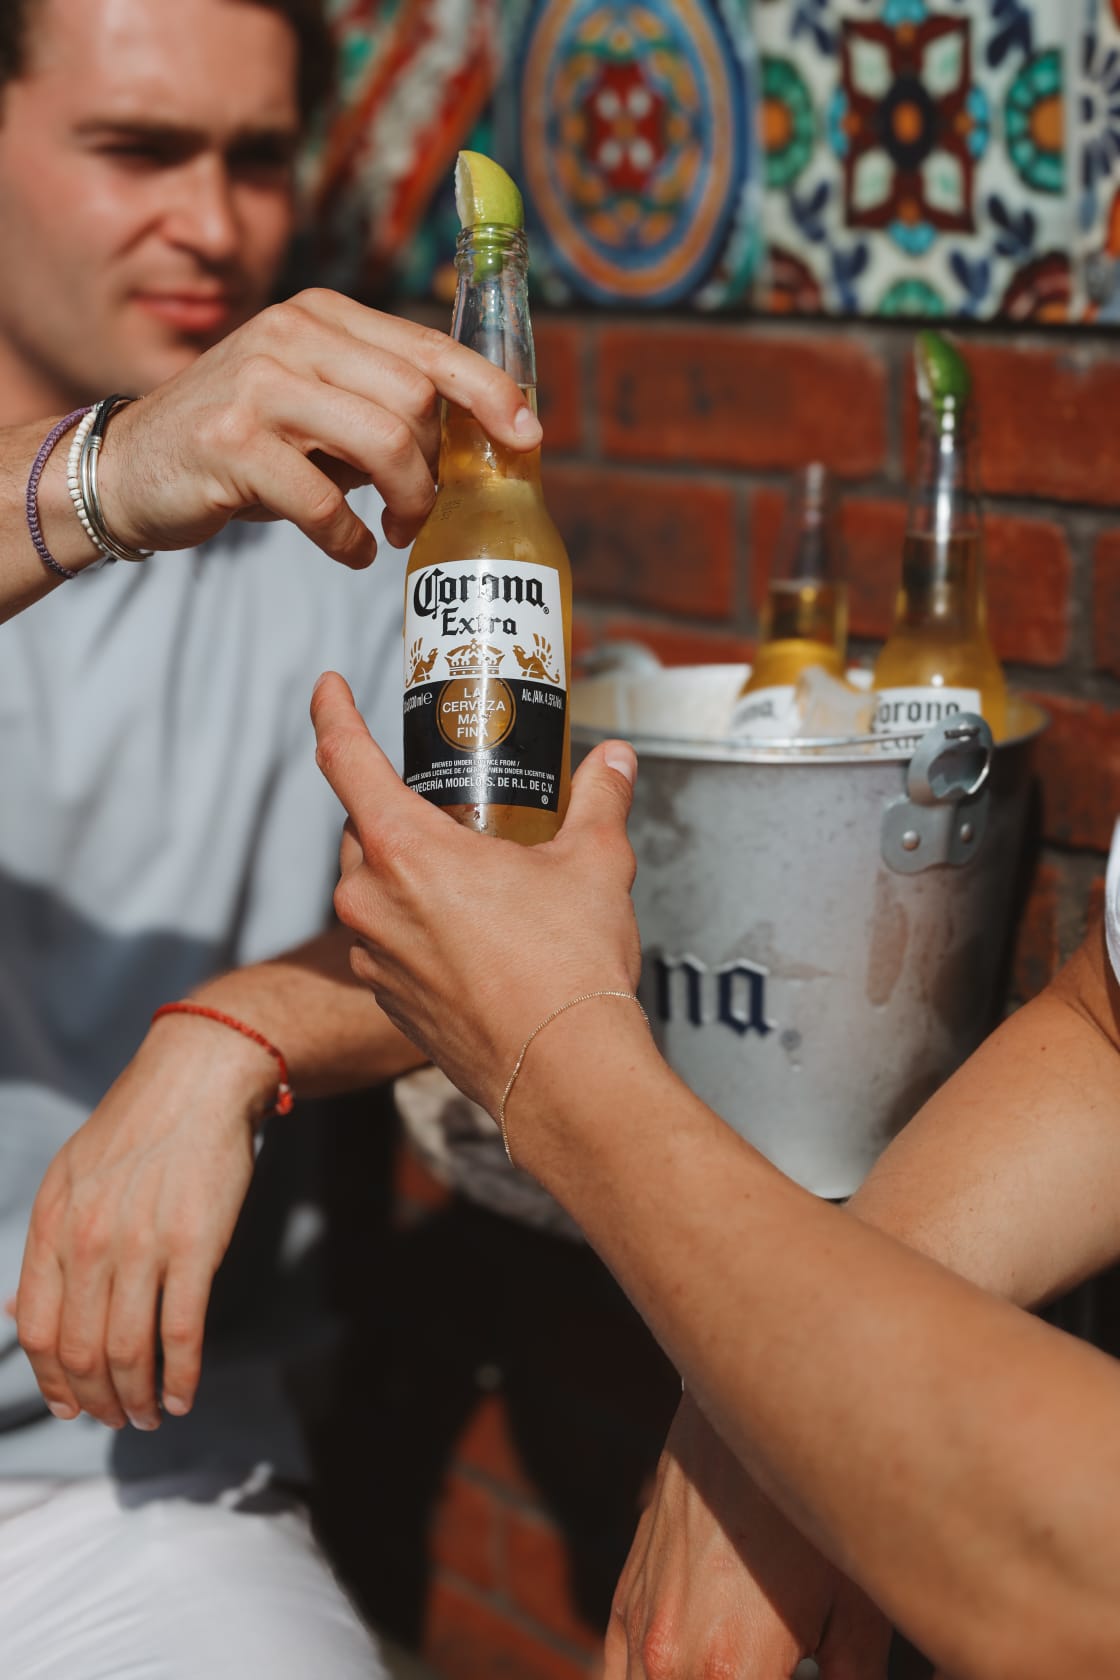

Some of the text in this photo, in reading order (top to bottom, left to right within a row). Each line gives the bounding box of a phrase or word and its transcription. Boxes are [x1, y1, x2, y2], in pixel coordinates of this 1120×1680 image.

[413, 568, 546, 619] Corona
[441, 607, 518, 637] Exra
[442, 700, 506, 713] CERVEZA
[457, 726, 489, 738] FINA
[497, 777, 510, 787] DE
[511, 778, 528, 789] R.L.
[529, 780, 540, 791] DE
[541, 782, 554, 794] C.V.
